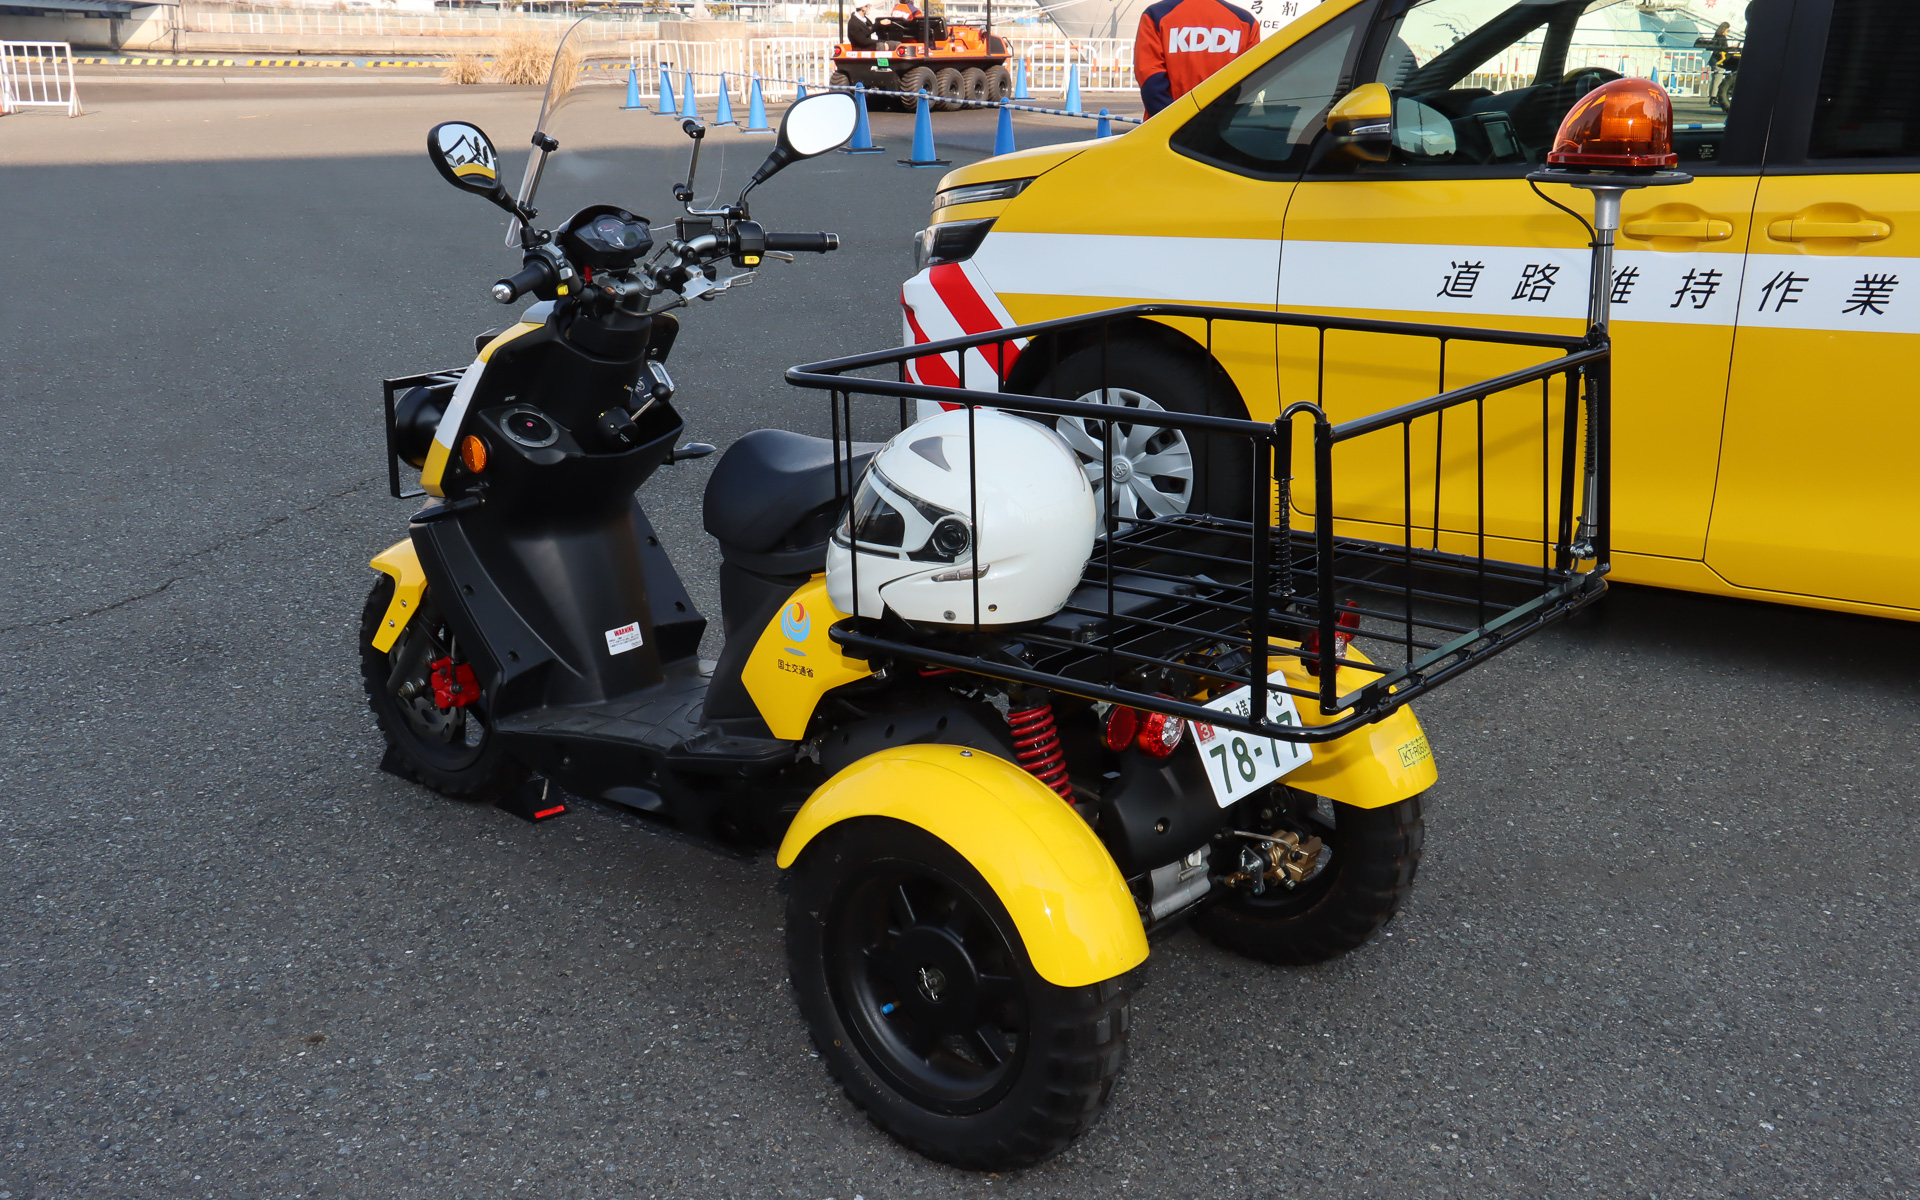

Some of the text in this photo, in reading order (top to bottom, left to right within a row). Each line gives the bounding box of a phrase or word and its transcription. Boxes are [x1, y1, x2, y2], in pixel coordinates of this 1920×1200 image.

[1168, 26, 1241, 53] KDDI
[777, 658, 814, 678] 国土交通省
